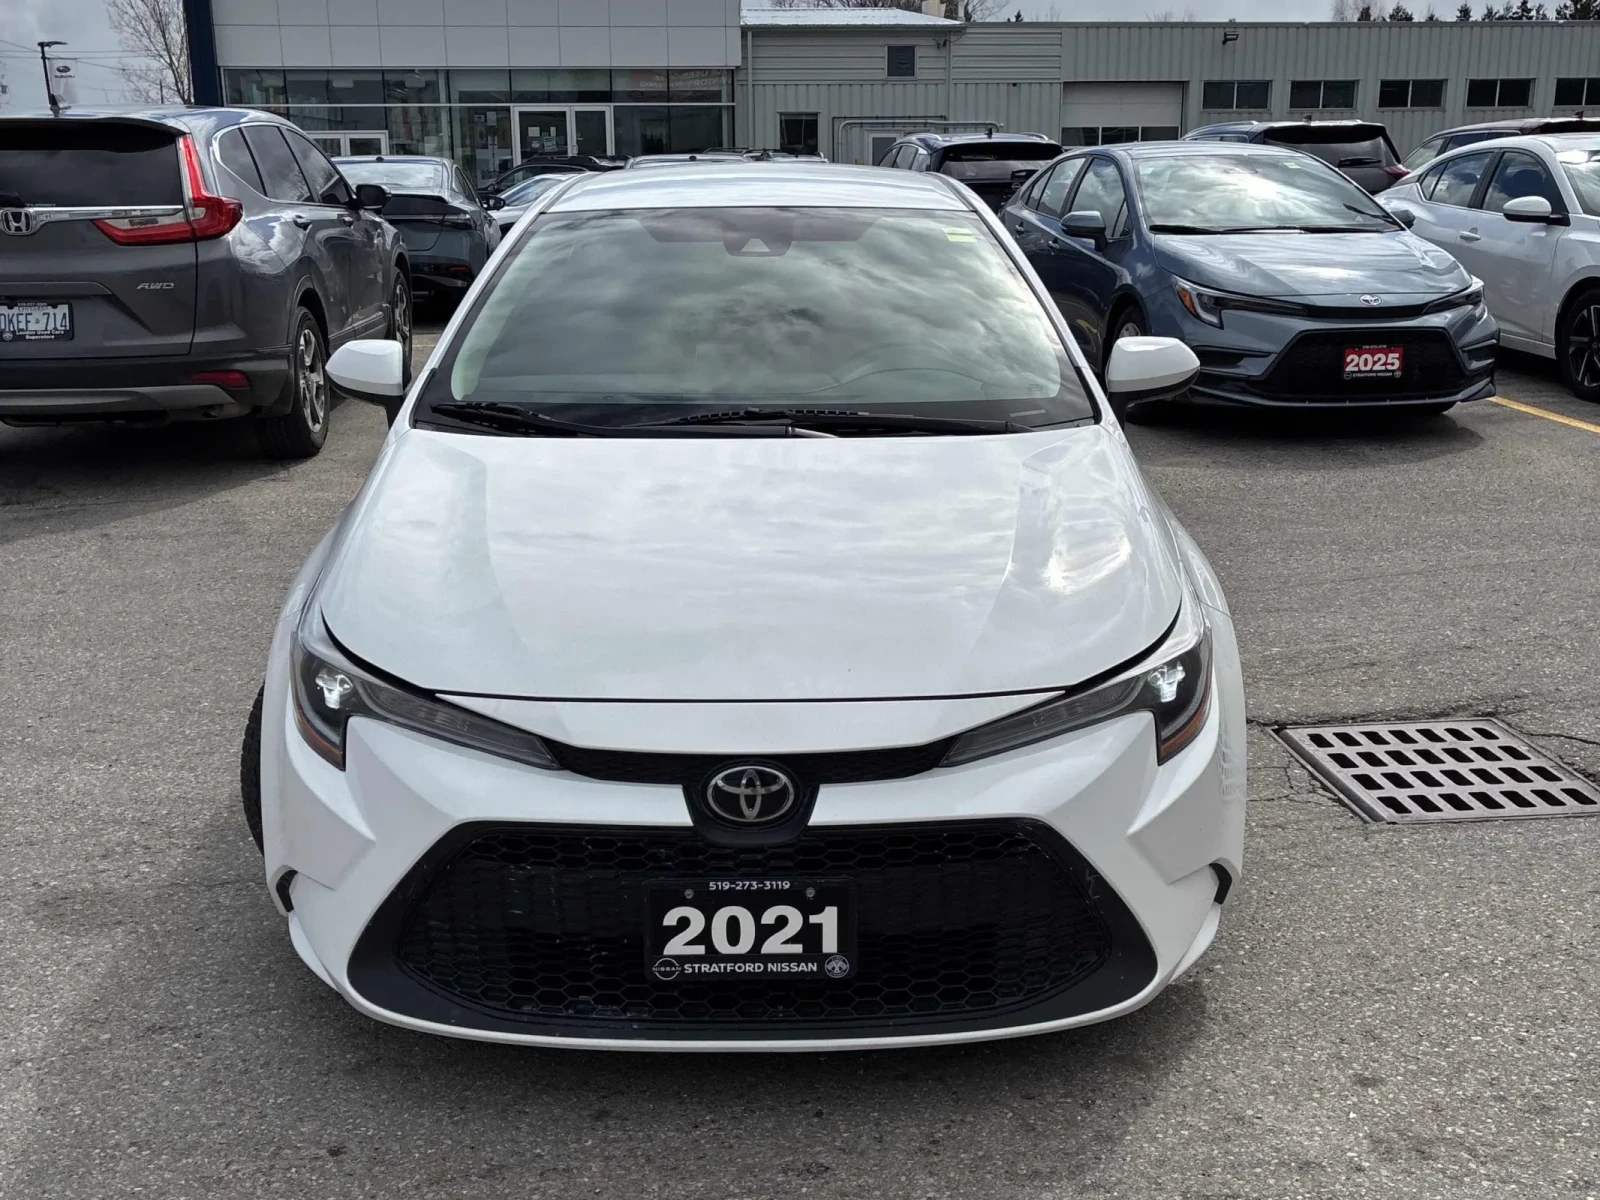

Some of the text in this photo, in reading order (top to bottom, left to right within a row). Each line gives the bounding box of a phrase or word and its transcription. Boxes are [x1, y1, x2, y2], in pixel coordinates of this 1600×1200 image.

[42, 312, 67, 331] 714
[1345, 353, 1400, 371] 2025
[708, 881, 791, 890] 519-273-3119
[662, 905, 838, 955] 2021
[684, 962, 818, 973] STRATFORD NISSAN
